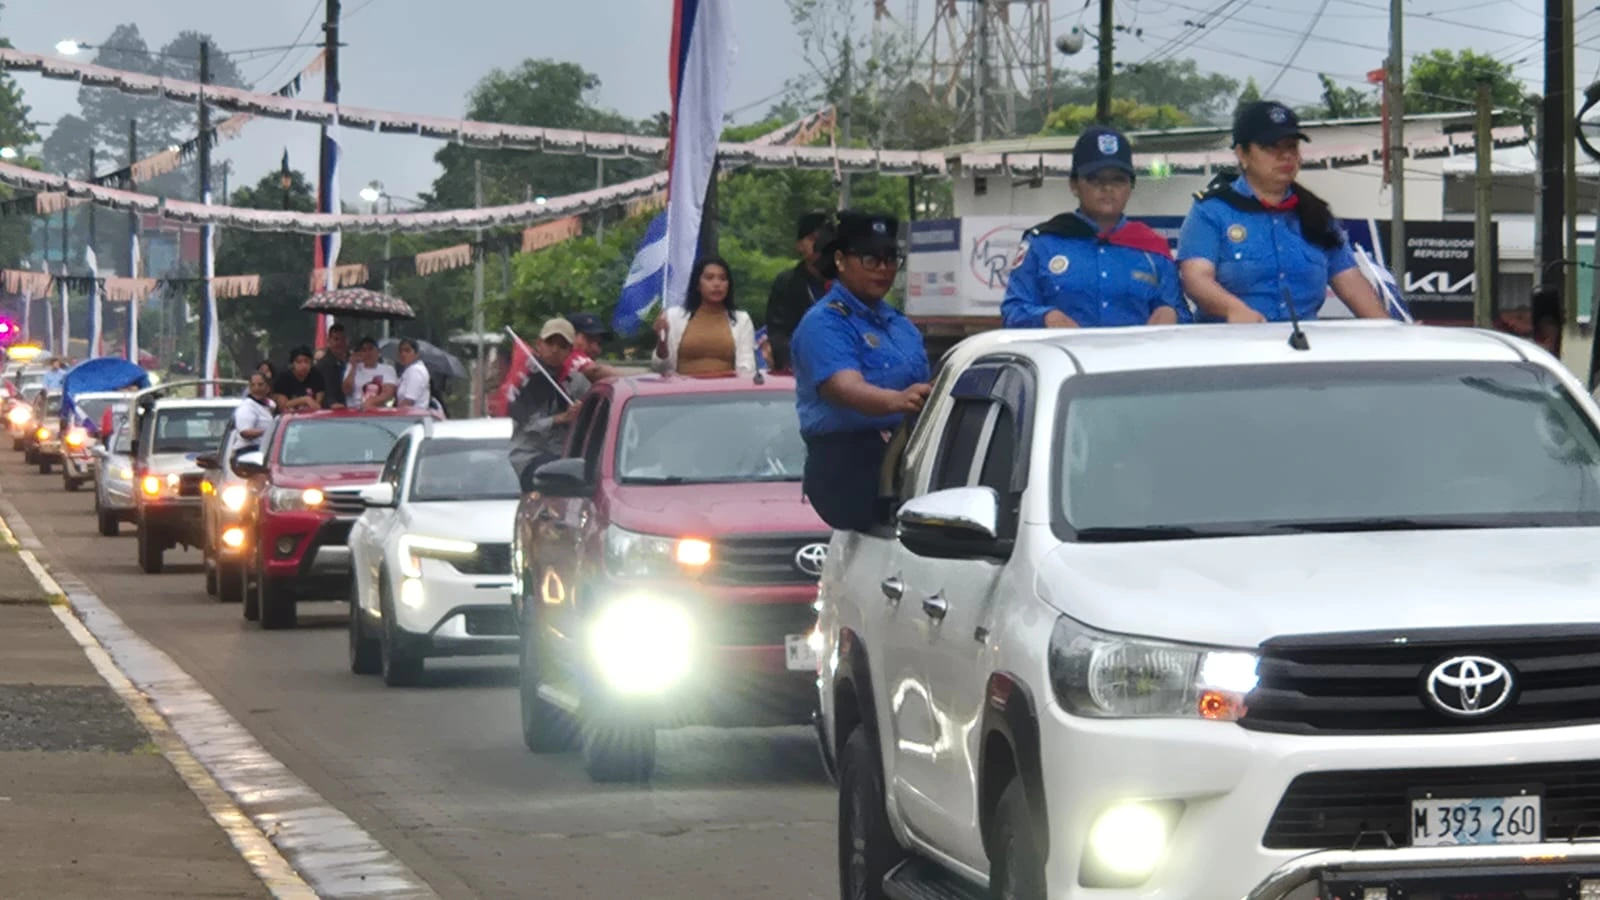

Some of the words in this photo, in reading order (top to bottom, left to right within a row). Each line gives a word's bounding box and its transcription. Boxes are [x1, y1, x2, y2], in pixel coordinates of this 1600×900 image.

[1407, 238, 1475, 248] DISTRIBUIDOR
[1413, 249, 1470, 259] REPUESTOS
[1404, 271, 1477, 293] KIA
[1414, 807, 1430, 838] M
[1437, 806, 1482, 838] 393
[1492, 804, 1536, 837] 260
